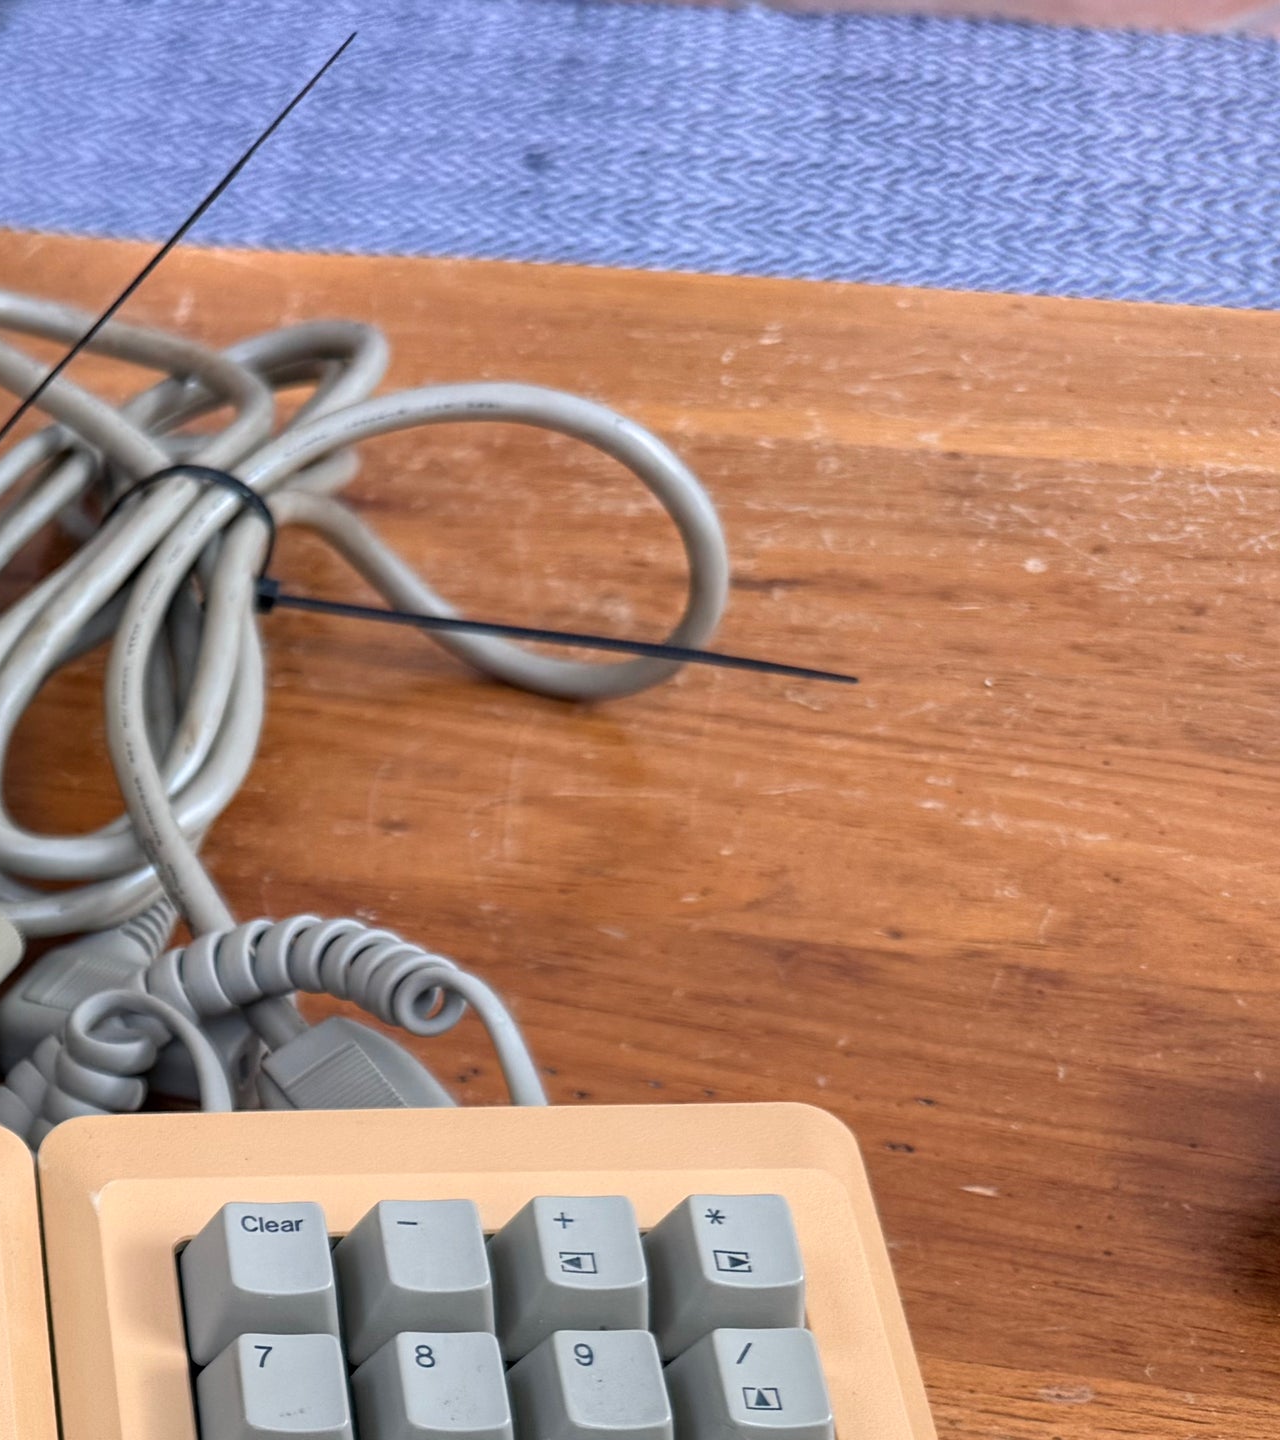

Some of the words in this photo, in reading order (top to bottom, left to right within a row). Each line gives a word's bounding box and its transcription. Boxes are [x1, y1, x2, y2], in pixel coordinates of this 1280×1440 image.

[240, 1214, 304, 1234] Clear
[552, 1211, 575, 1230] +
[253, 1344, 274, 1369] 7
[414, 1344, 437, 1369] 8
[573, 1342, 595, 1367] 9
[735, 1342, 753, 1365] /
